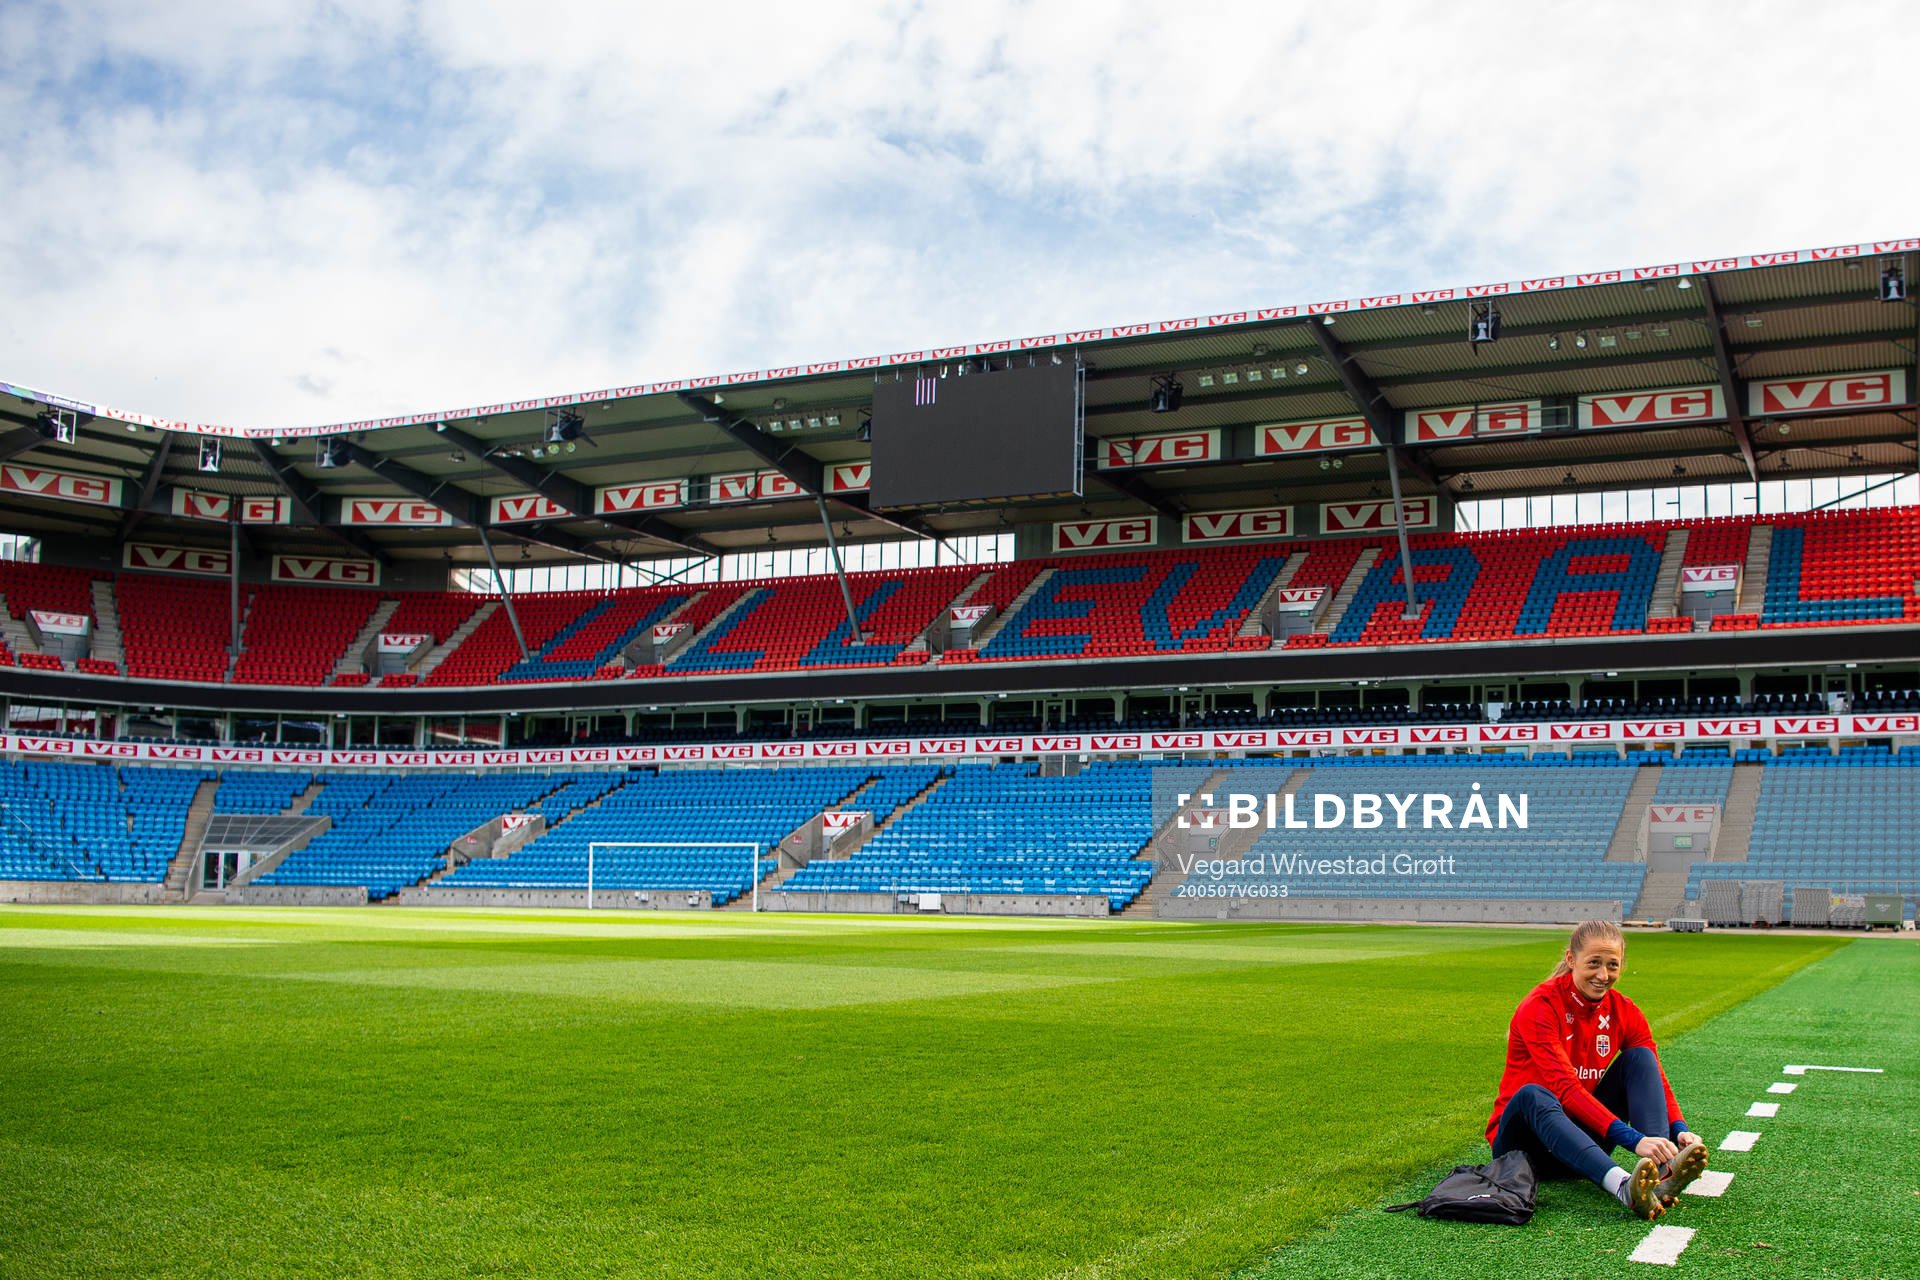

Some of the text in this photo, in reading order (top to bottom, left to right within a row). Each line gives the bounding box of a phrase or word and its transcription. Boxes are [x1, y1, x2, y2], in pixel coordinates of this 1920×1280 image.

[283, 428, 310, 437] VG
[319, 424, 341, 434] VG
[349, 420, 372, 430] VG
[380, 416, 404, 427] VG
[412, 413, 436, 423] VG
[444, 408, 469, 420] VG
[478, 404, 502, 415] VG
[511, 400, 536, 411] VG
[545, 395, 571, 406] VG
[581, 390, 606, 401] VG
[616, 385, 643, 397] VG
[653, 381, 680, 392] VG
[690, 376, 718, 387] VG
[729, 371, 757, 383] VG
[768, 367, 797, 378] VG
[808, 362, 837, 374] VG
[849, 357, 879, 368] VG
[890, 351, 922, 364] VG
[933, 346, 965, 358] VG
[977, 341, 1009, 353] VG
[1021, 335, 1055, 348] VG
[1067, 330, 1101, 342] VG
[1113, 324, 1148, 337] VG
[1161, 319, 1197, 331] VG
[1209, 313, 1245, 326] VG
[1259, 307, 1296, 320] VG
[1309, 301, 1347, 314] VG
[1361, 295, 1400, 308] VG
[1413, 289, 1453, 303] VG
[1467, 283, 1507, 297] VG
[1522, 277, 1563, 291] VG
[1577, 271, 1619, 285] VG
[1635, 265, 1678, 279] VG
[1693, 258, 1737, 273] VG
[1752, 252, 1797, 267] VG
[1812, 245, 1858, 261] VG
[1875, 239, 1919, 254] VG
[1767, 377, 1883, 409] VG
[1595, 392, 1706, 423] VG
[1267, 421, 1366, 450] VG
[1421, 408, 1522, 437] VG
[1112, 436, 1203, 463] VG
[5, 467, 104, 498] VG
[722, 475, 797, 498] VG
[836, 465, 871, 488] V
[188, 495, 275, 522] VG
[606, 485, 676, 509] VG
[355, 502, 438, 522] VG
[1191, 512, 1281, 538] VG
[1329, 502, 1424, 528] VG
[1062, 521, 1146, 546] VG
[134, 546, 227, 573] VG
[282, 559, 369, 582] VG
[1686, 568, 1734, 581] VG
[1282, 589, 1323, 602] VG
[38, 613, 82, 627] VG
[19, 738, 71, 753] VG
[85, 743, 136, 757] VG
[150, 746, 199, 760] VG
[213, 748, 261, 762] VG
[274, 751, 321, 764] VG
[332, 752, 375, 765] VG
[387, 752, 426, 765] VG
[436, 752, 473, 765] VG
[484, 751, 517, 764] VG
[527, 750, 562, 763] VG
[572, 749, 607, 762] VG
[618, 748, 654, 761] VG
[665, 746, 702, 760] VG
[713, 745, 752, 759] VG
[763, 744, 803, 757] VG
[814, 742, 855, 756] VG
[867, 741, 909, 755] VG
[921, 739, 965, 753] VG
[976, 738, 1021, 752] VG
[1034, 737, 1080, 751] VG
[1092, 735, 1139, 750] VG
[1153, 734, 1202, 748] VG
[1215, 732, 1265, 747] VG
[1279, 730, 1330, 746] VG
[1344, 728, 1397, 744] VG
[1411, 727, 1466, 743] VG
[1480, 725, 1537, 742] VG
[1552, 723, 1609, 740] VG
[1624, 721, 1684, 738] VG
[1699, 719, 1760, 736] VG
[1775, 718, 1838, 735] VG
[1853, 716, 1919, 734] VG
[1652, 807, 1713, 822] VG
